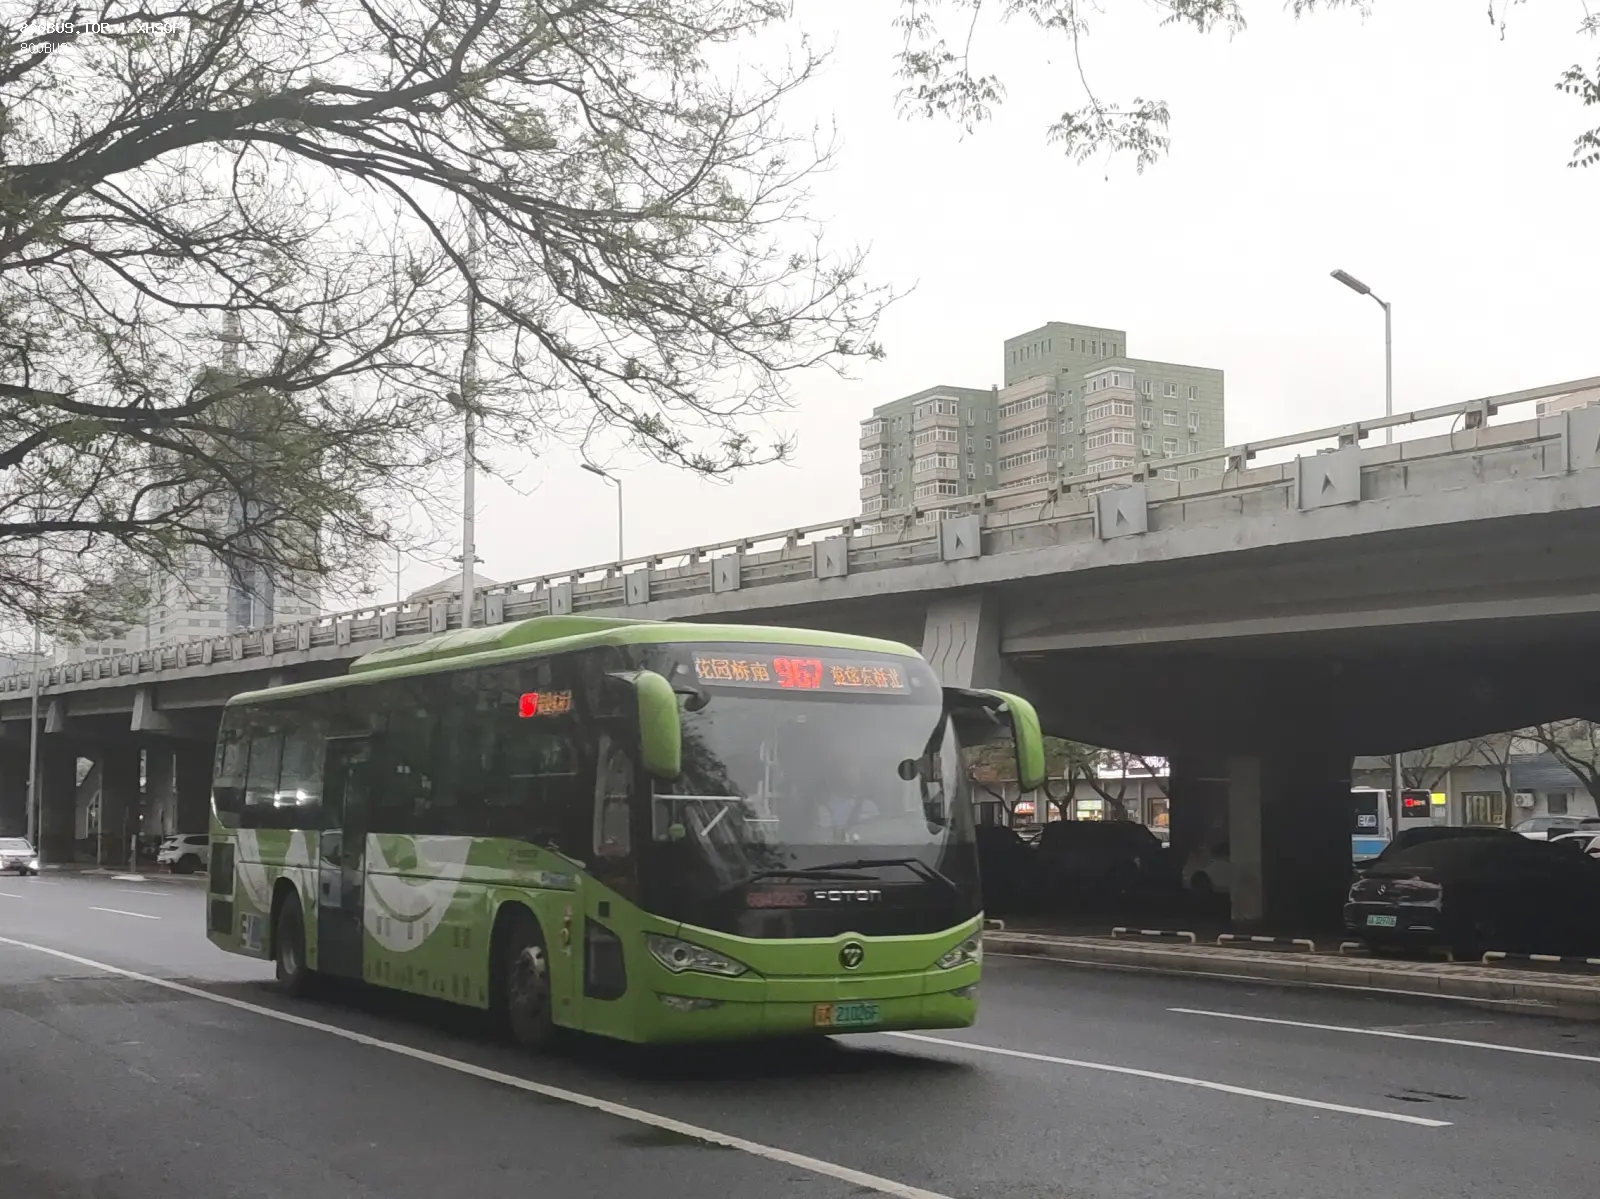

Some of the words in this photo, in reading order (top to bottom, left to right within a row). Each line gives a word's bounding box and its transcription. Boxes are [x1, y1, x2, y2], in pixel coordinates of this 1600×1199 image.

[695, 657, 770, 682] 花园桥南
[773, 657, 824, 688] 967
[814, 890, 881, 902] FOTON
